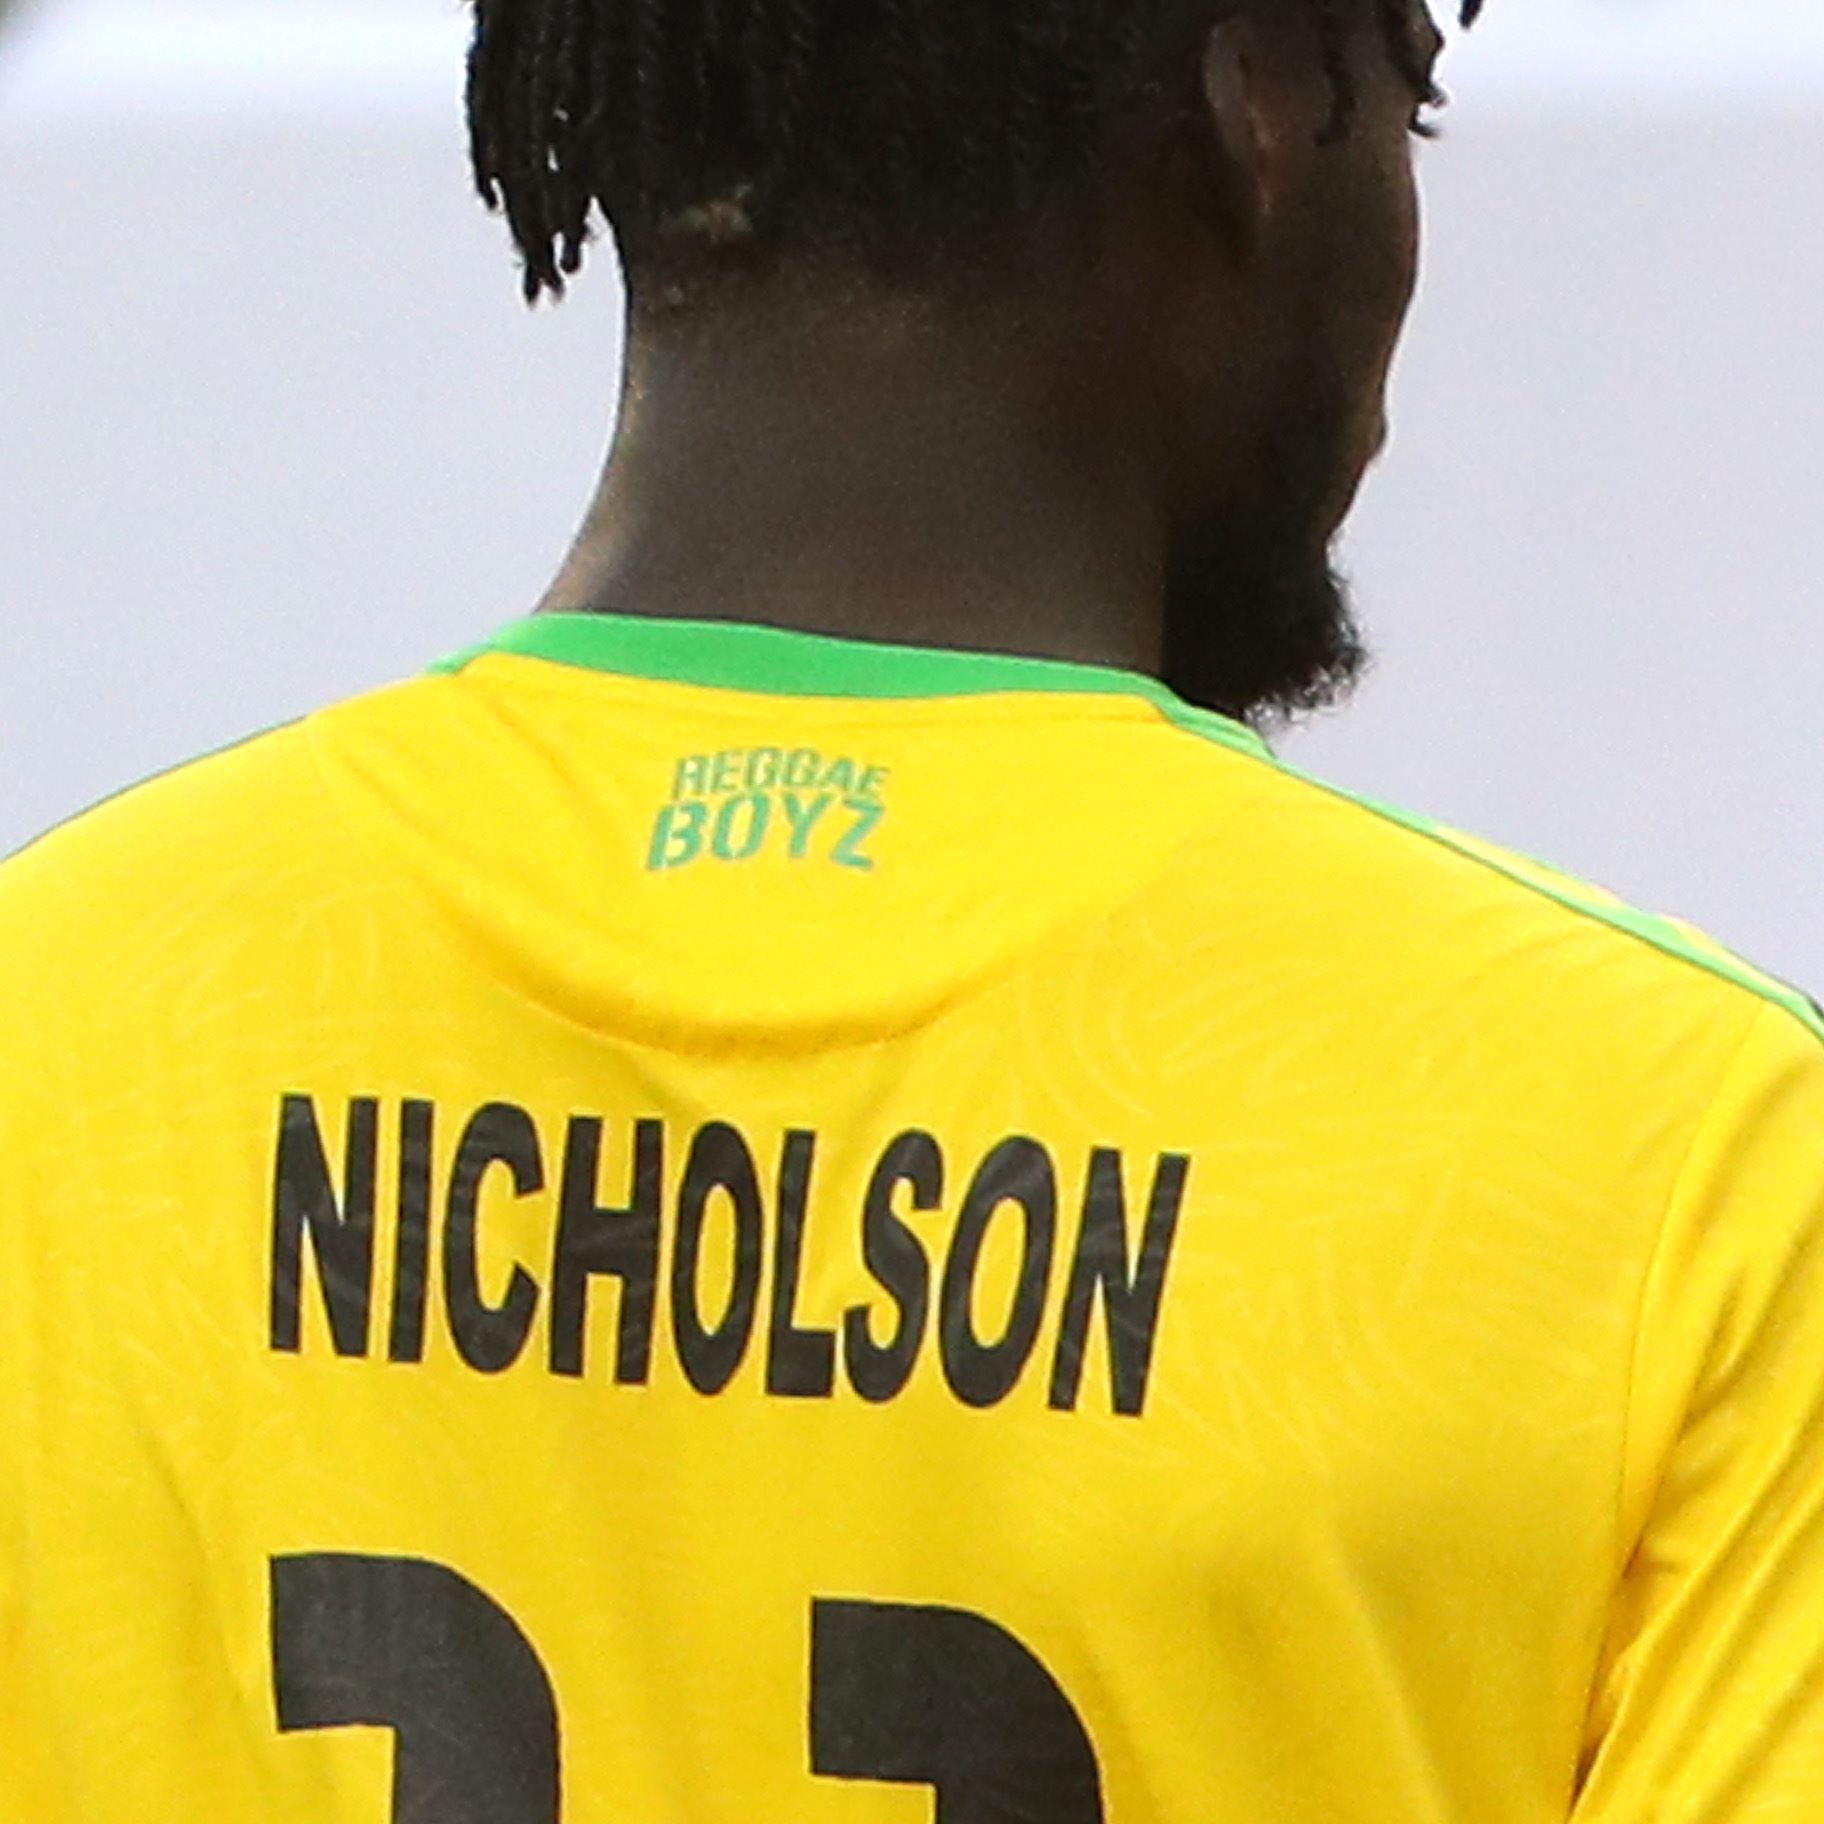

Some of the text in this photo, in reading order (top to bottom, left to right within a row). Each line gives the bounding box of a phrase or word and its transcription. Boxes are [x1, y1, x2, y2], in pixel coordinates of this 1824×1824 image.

[673, 745, 890, 799] REGGAE
[645, 793, 886, 870] BOYZ
[269, 1092, 1190, 1418] NICHOLSON
